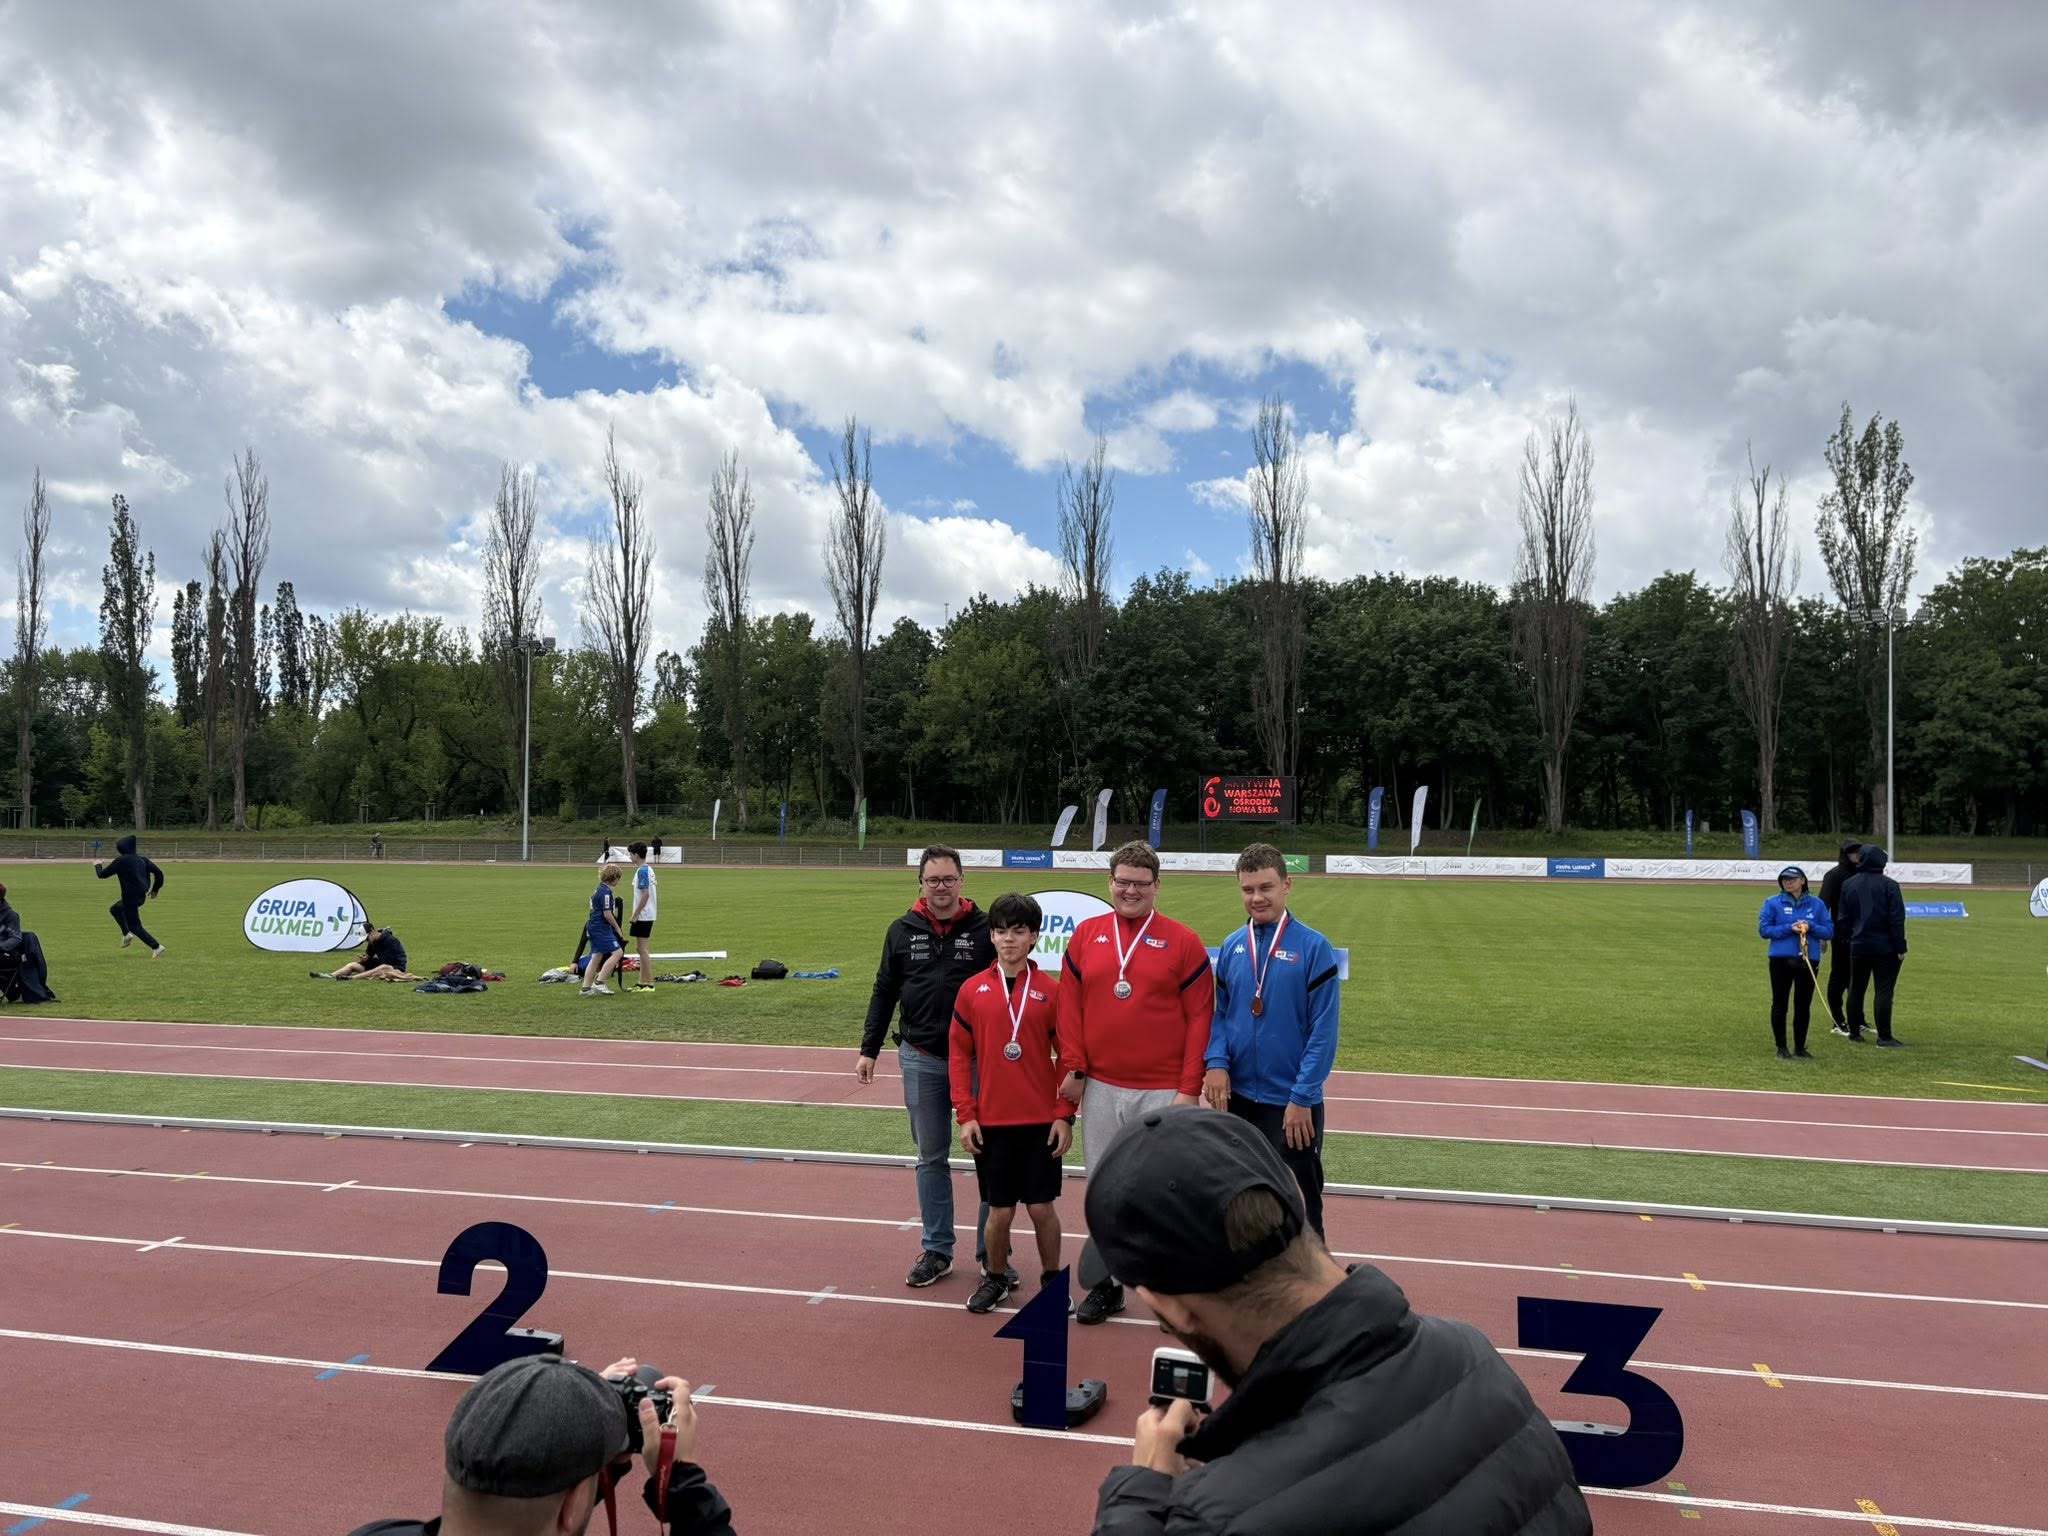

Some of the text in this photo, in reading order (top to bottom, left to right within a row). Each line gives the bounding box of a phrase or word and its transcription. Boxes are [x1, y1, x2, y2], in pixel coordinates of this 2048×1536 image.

[1224, 789, 1281, 798] WARSZAWA
[257, 898, 316, 918] GRUPA
[250, 916, 324, 938] LUXMED
[1040, 914, 1076, 933] UPA
[426, 1221, 549, 1376] 2
[993, 1264, 1071, 1431] 1
[1517, 1296, 1685, 1489] 3
